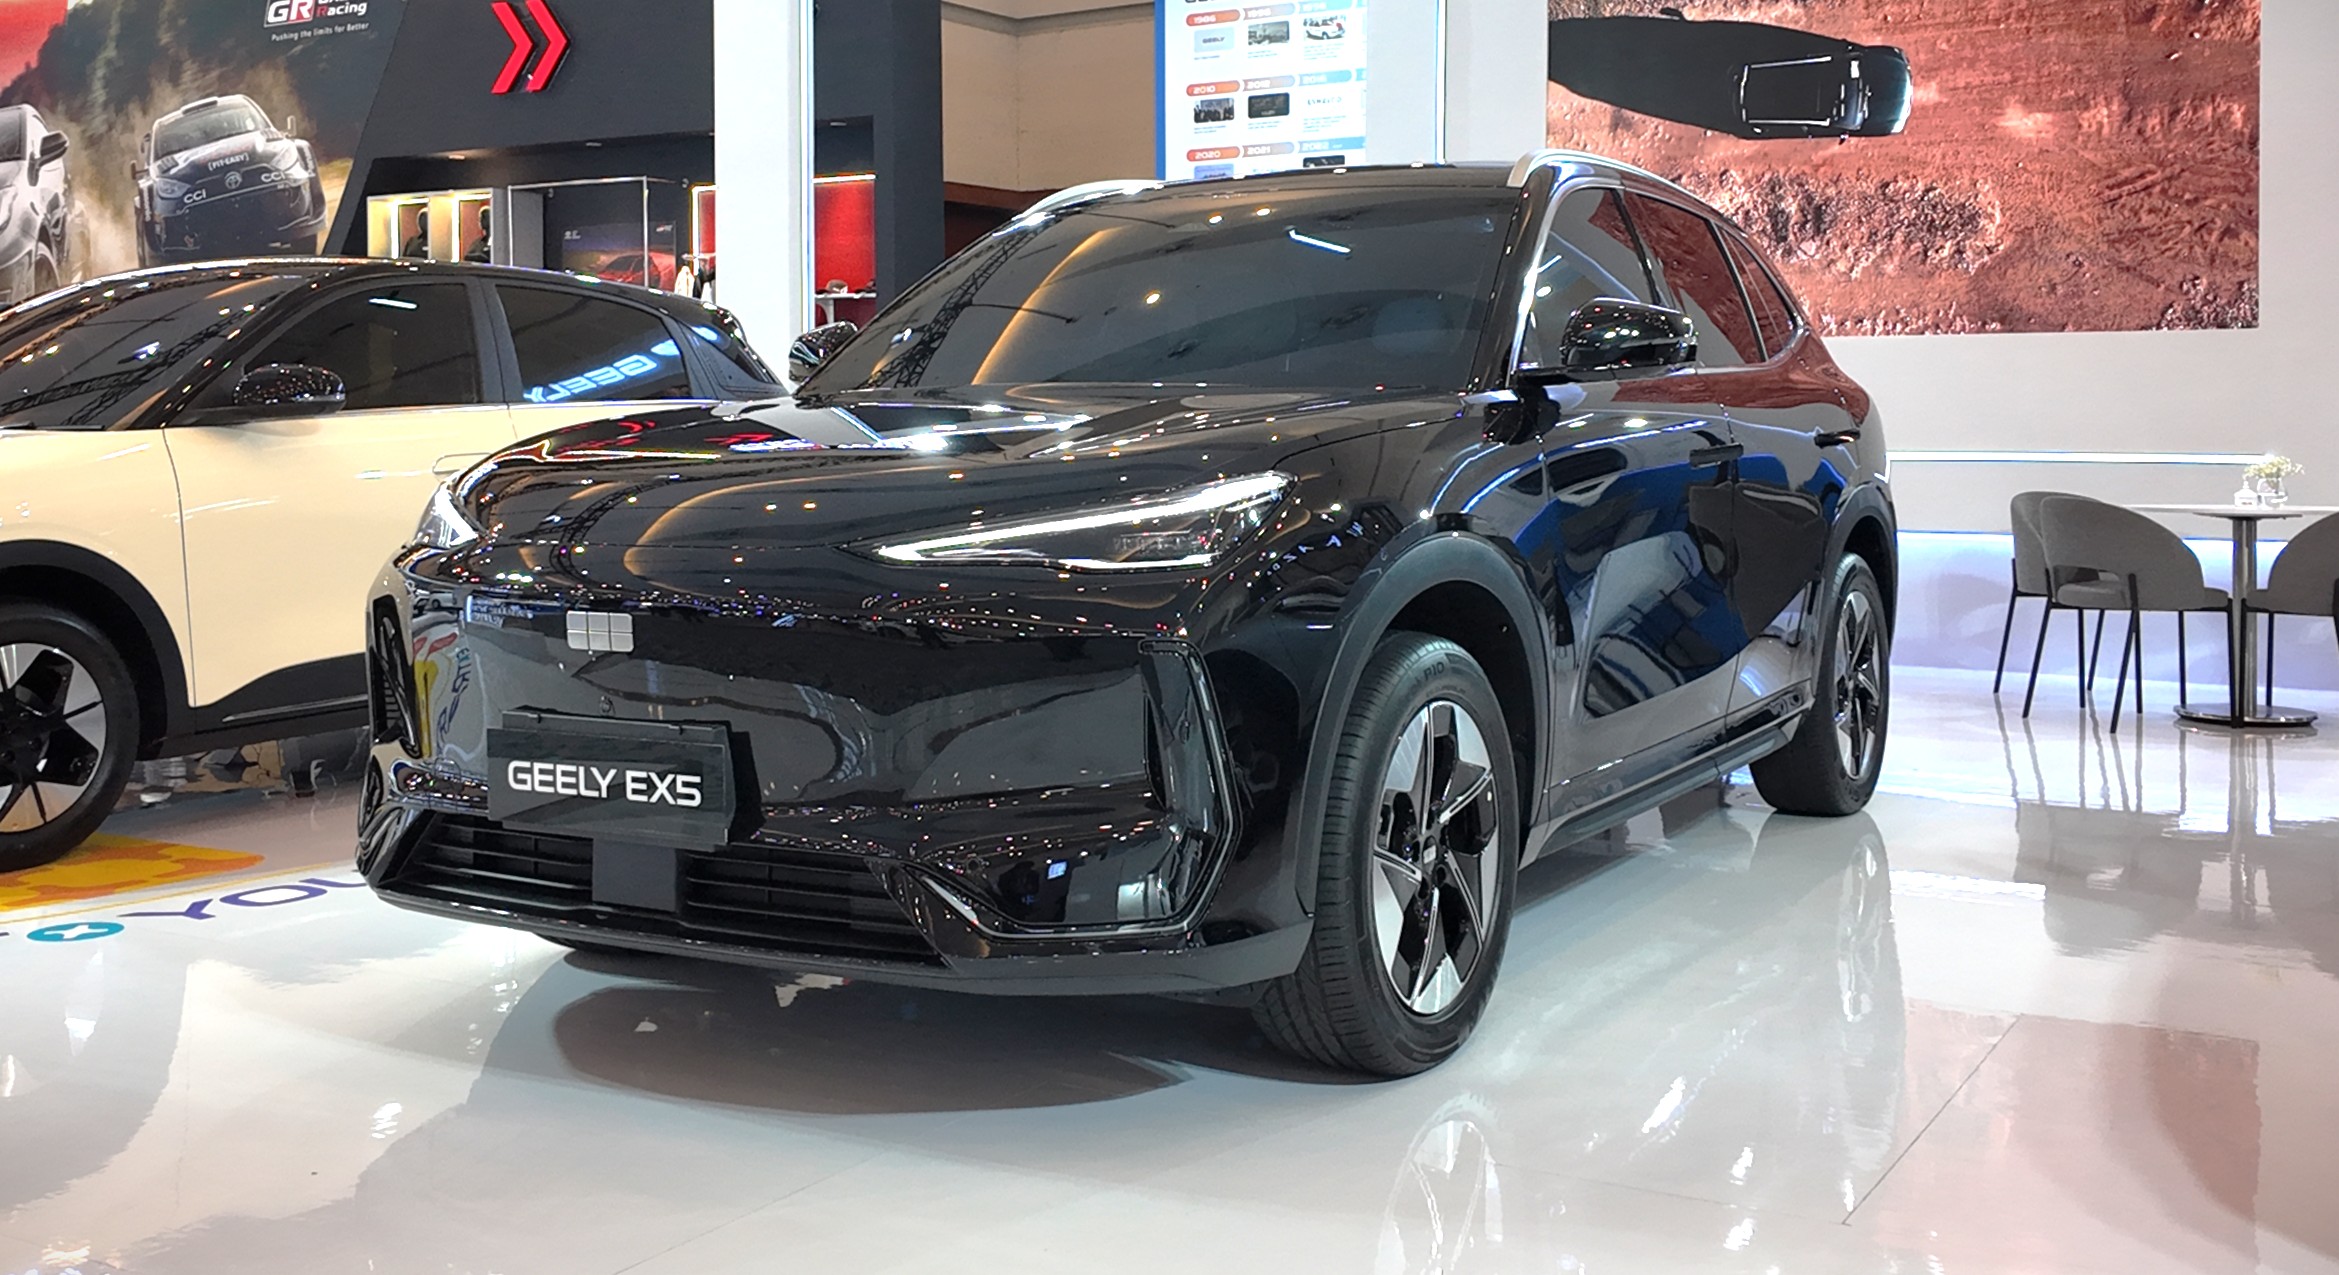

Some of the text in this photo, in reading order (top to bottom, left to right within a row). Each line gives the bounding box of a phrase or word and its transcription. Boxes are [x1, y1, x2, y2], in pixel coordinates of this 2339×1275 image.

[267, 0, 313, 23] GR
[316, 2, 367, 17] Racing
[271, 22, 369, 41] Pushing the limits for Better
[1193, 85, 1216, 95] 2010
[1195, 151, 1221, 160] 2020
[261, 171, 285, 183] CCI
[183, 189, 207, 204] CCI
[507, 760, 702, 808] GEELY EX5
